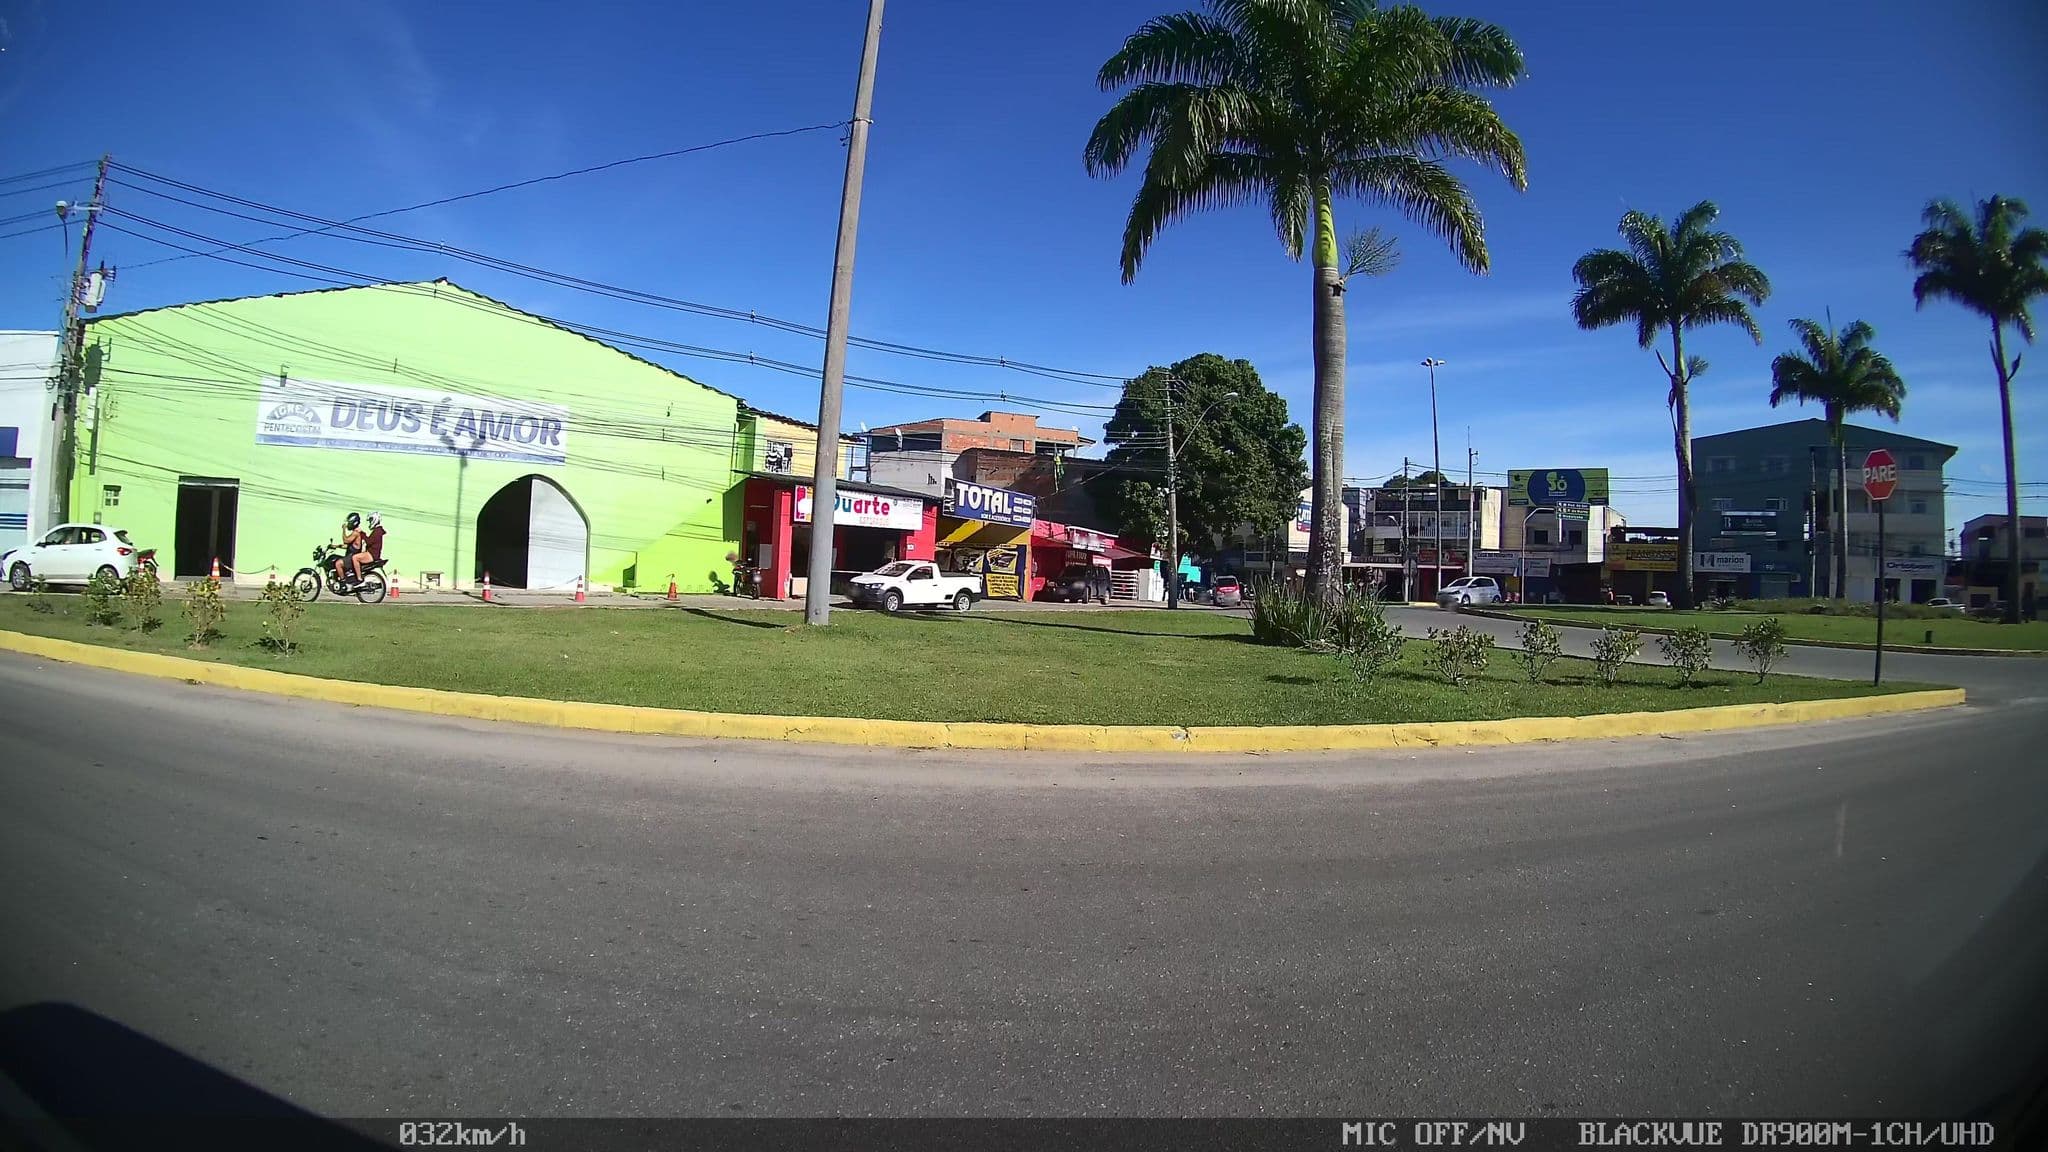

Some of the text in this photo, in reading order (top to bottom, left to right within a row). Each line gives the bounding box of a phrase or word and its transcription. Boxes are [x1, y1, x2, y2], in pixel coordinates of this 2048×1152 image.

[330, 396, 563, 447] DEUS É AMOR
[1862, 464, 1897, 483] PARE
[956, 482, 1012, 514] TOTAL
[1717, 555, 1745, 564] marion
